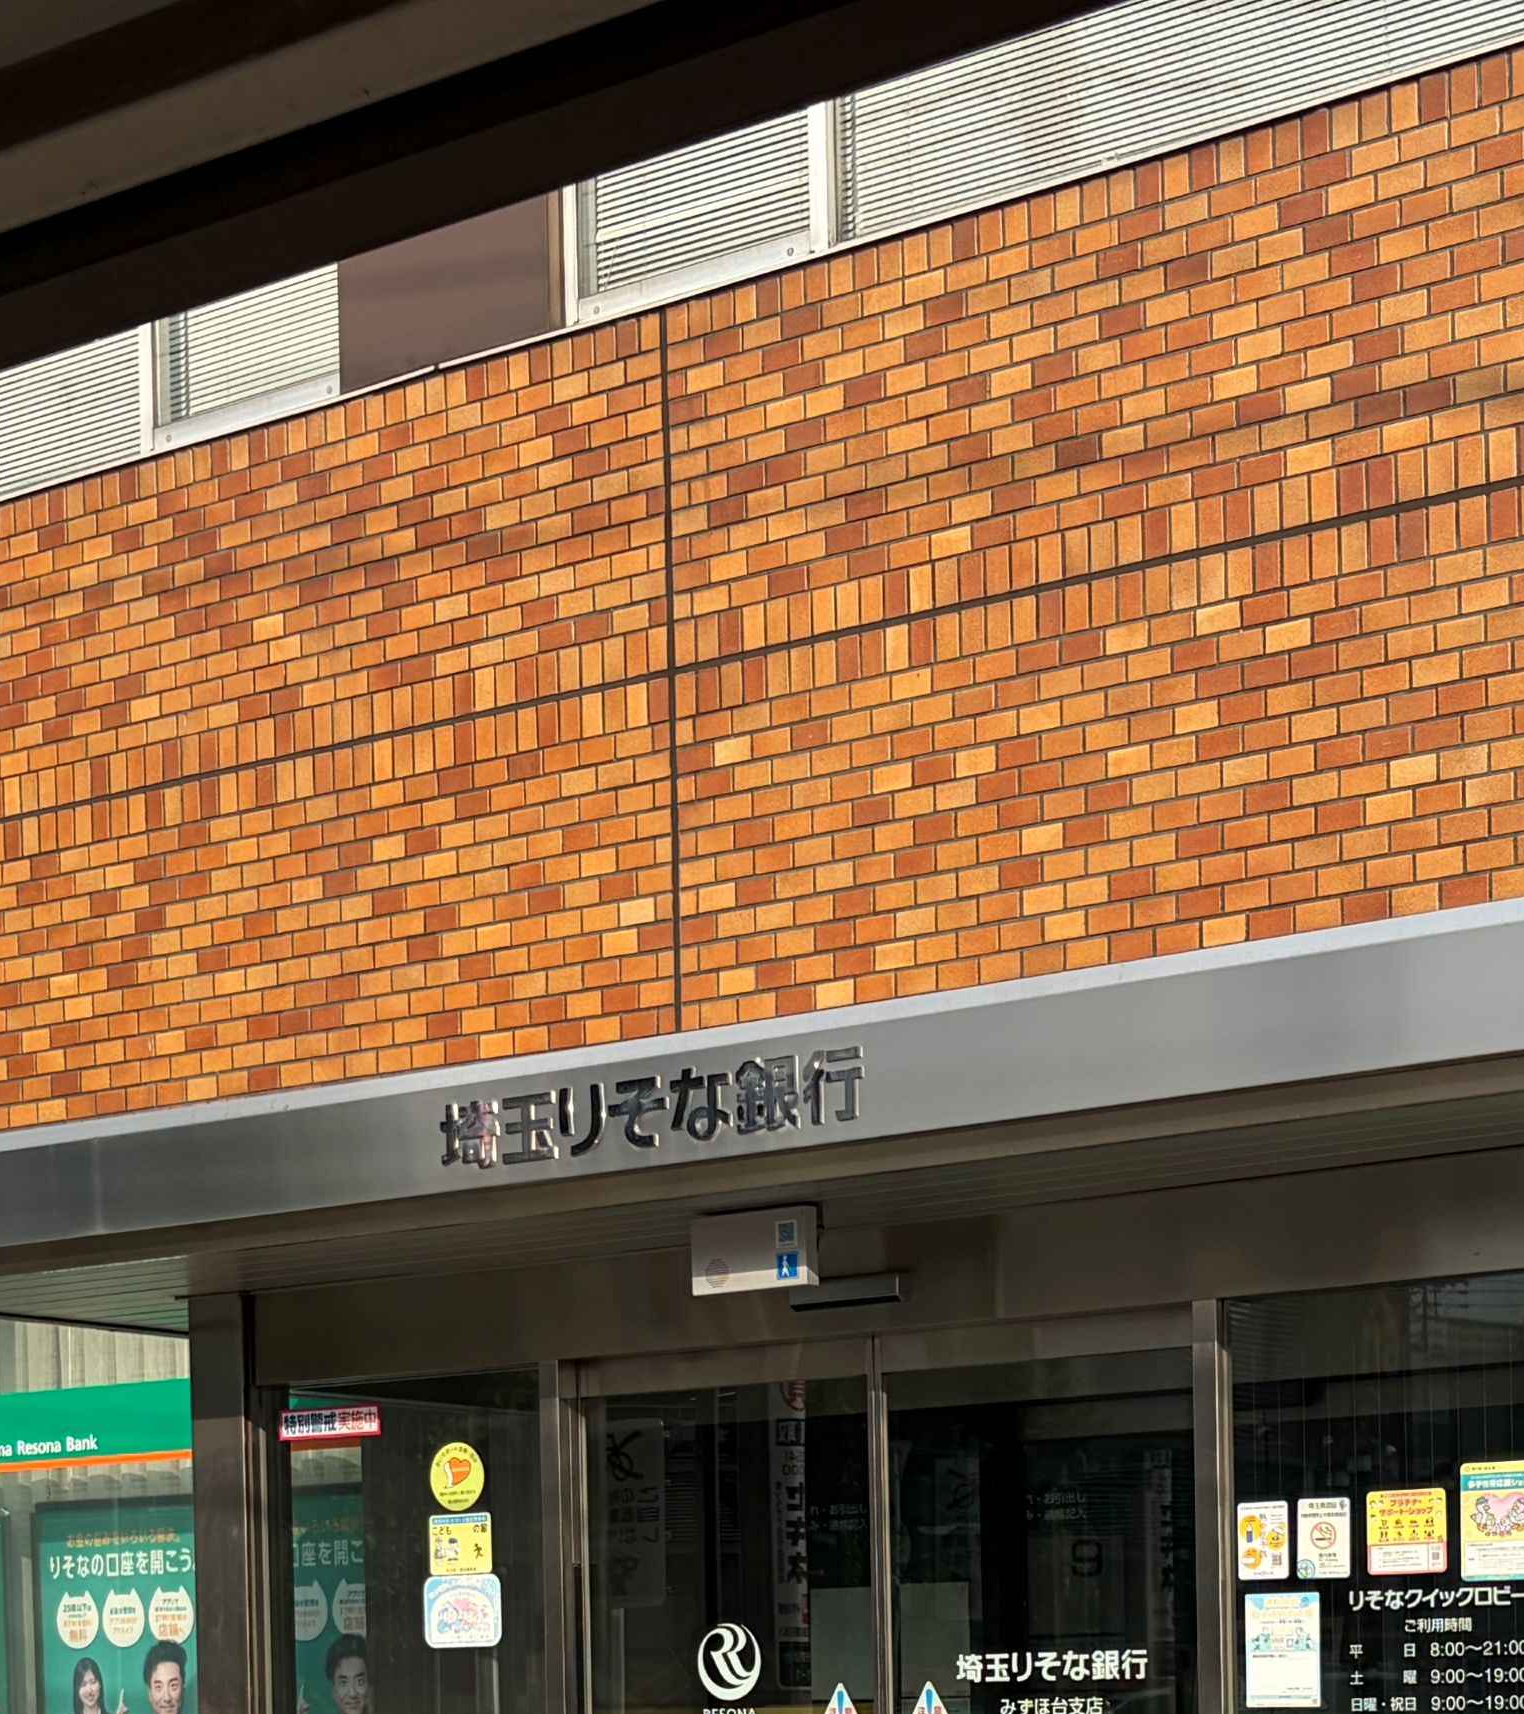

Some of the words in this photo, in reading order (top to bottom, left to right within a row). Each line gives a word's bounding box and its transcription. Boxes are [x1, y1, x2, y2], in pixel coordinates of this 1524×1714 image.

[440, 1044, 865, 1170] 埼玉りそな銀行
[284, 1408, 377, 1436] 特別警戒実施中
[17, 1439, 61, 1455] Resona
[66, 1434, 98, 1451] Bank
[293, 1541, 364, 1568] 座を開こ
[1404, 1617, 1473, 1633] ご利用時間
[956, 1649, 1148, 1683] 埼玉りそな銀行
[1351, 1697, 1417, 1713] 日曜・祝日
